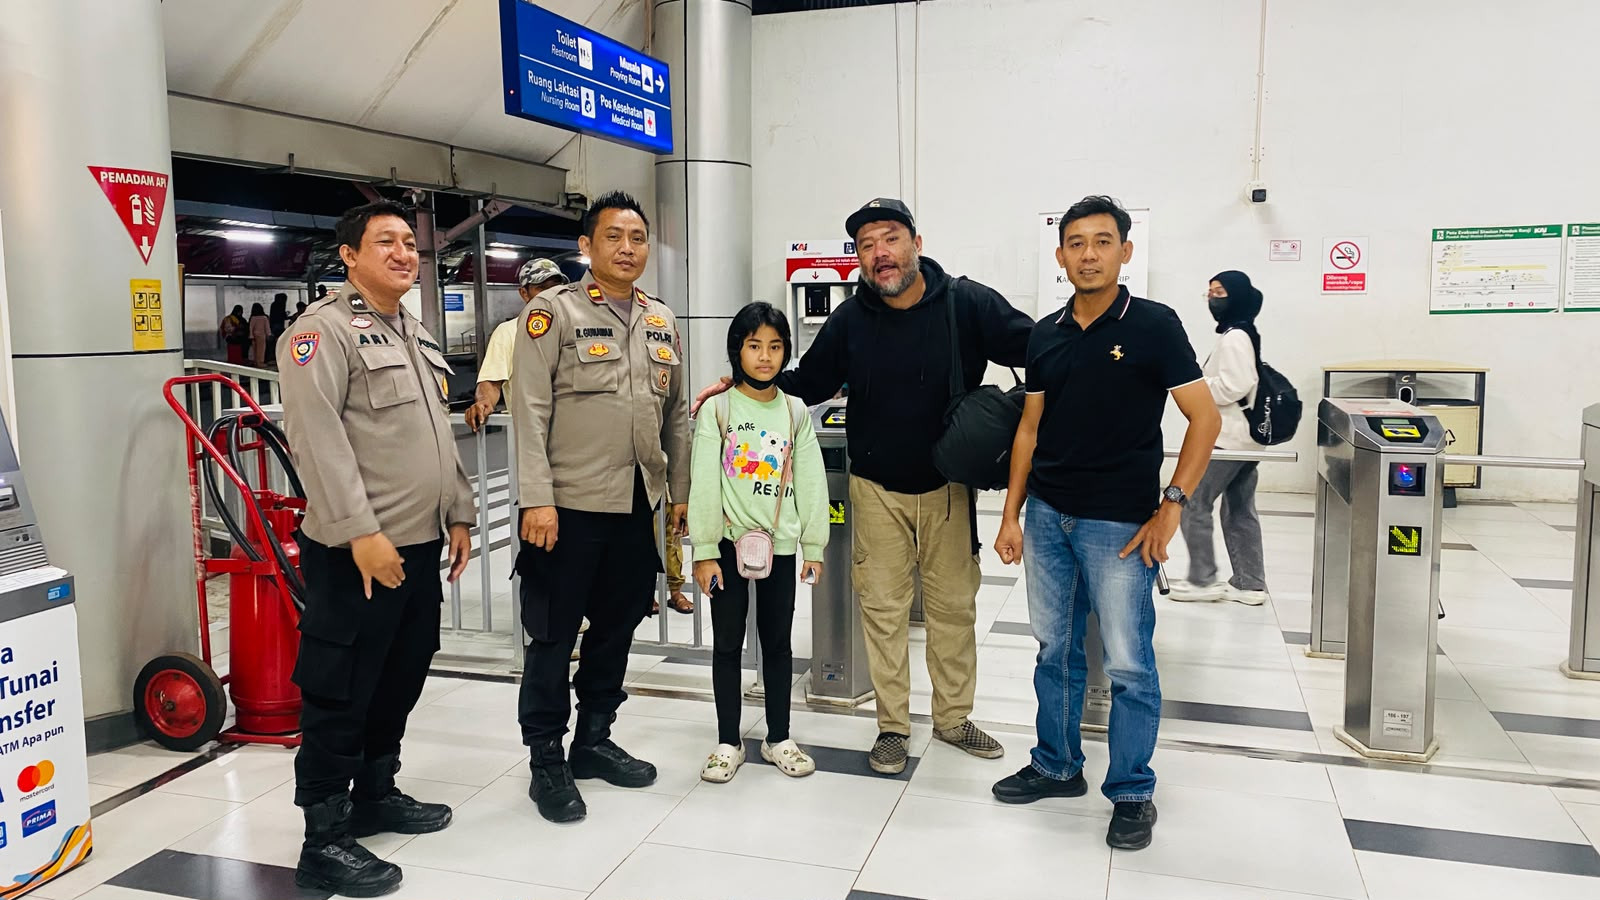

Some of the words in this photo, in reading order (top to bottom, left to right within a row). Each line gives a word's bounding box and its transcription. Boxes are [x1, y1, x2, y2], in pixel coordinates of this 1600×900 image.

[556, 29, 577, 49] Toilet
[551, 44, 578, 63] Restroom
[619, 55, 641, 75] Musala
[528, 70, 553, 91] Ruang
[553, 82, 580, 99] Laktasi
[609, 67, 628, 86] Praying
[628, 73, 642, 87] Room
[541, 91, 564, 109] Nursing
[564, 97, 580, 112] Room
[600, 94, 612, 109] Pos
[612, 99, 643, 119] Kesehatan
[611, 113, 630, 128] Medical
[630, 121, 644, 132] Room
[100, 171, 155, 186] PEMADAM
[155, 177, 167, 189] API
[359, 333, 389, 346] ARI
[575, 328, 583, 339] R.
[646, 330, 672, 343] POLRI
[727, 424, 733, 433] E
[737, 422, 755, 432] ARE
[0, 660, 58, 700] Tunai
[22, 733, 42, 748] Apa
[44, 725, 64, 742] pun
[19, 783, 55, 803] mastercard
[26, 810, 52, 827] PRIMA
